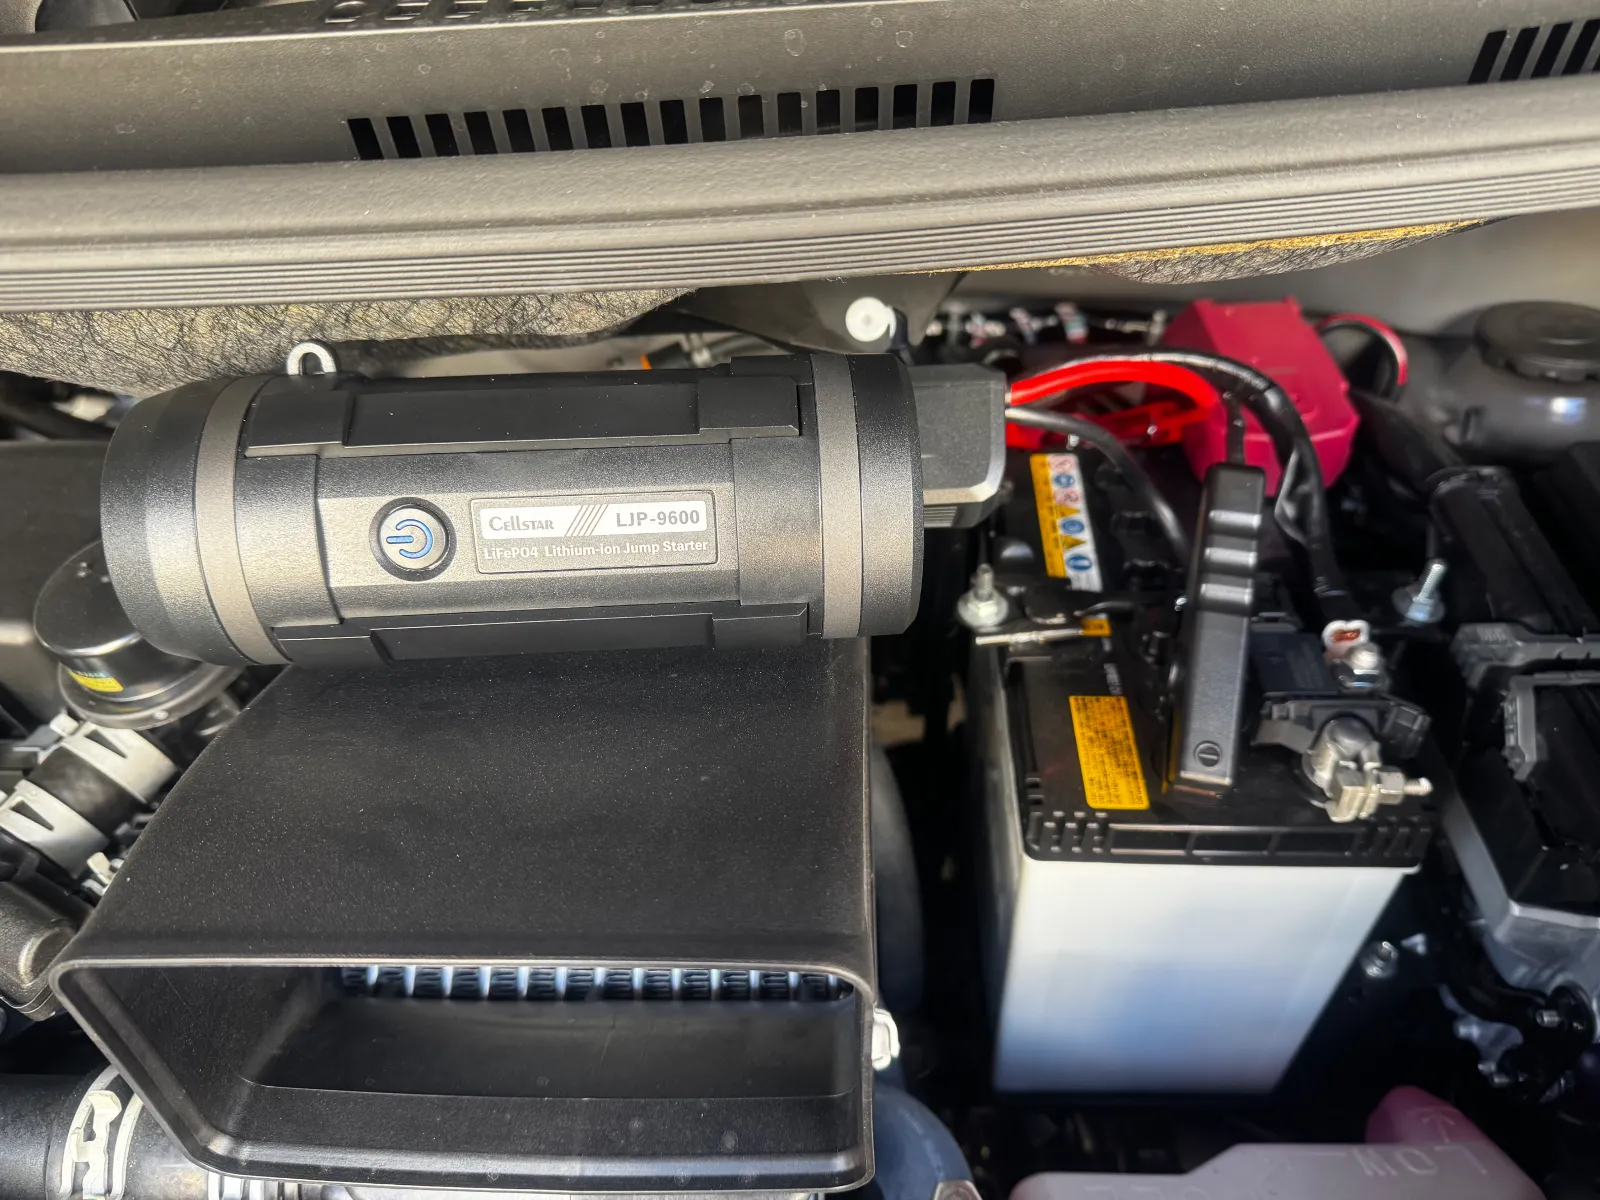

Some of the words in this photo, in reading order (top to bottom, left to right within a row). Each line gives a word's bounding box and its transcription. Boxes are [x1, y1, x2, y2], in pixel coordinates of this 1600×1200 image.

[616, 509, 701, 527] LJP-9600
[484, 546, 539, 560] LiFePO4
[544, 543, 621, 557] Lithium-ion
[623, 542, 660, 554] Jump
[663, 541, 709, 552] Starter
[1352, 1144, 1489, 1177] LOW
